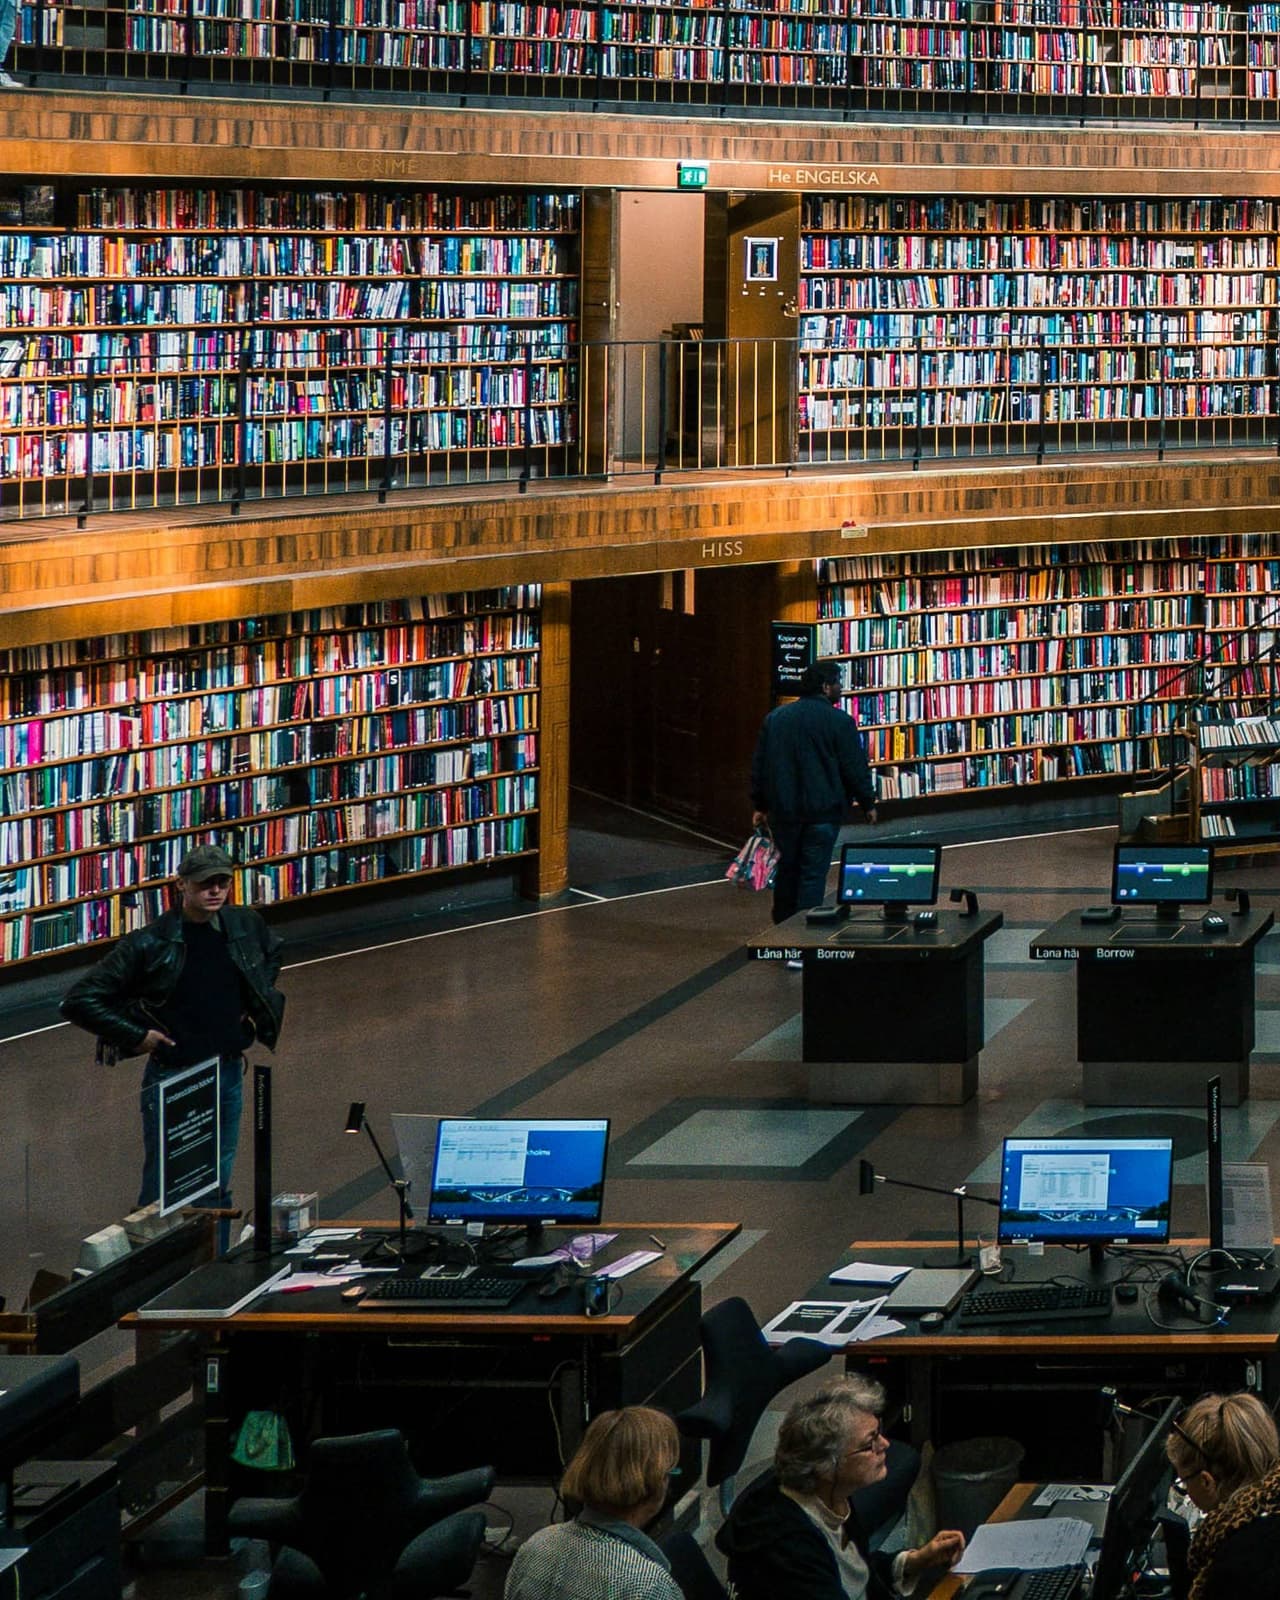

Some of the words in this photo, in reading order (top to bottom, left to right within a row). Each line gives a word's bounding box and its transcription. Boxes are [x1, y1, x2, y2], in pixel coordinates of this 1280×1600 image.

[357, 158, 418, 175] CRIME
[769, 168, 791, 183] He
[796, 169, 880, 185] ENGELSKA
[702, 541, 743, 558] HISS
[390, 675, 398, 685] S
[1205, 682, 1214, 690] W
[757, 947, 783, 959] Låna
[784, 948, 803, 959] här
[817, 948, 856, 959] Borrow
[1096, 947, 1135, 958] Borrow
[257, 1074, 265, 1130] Information
